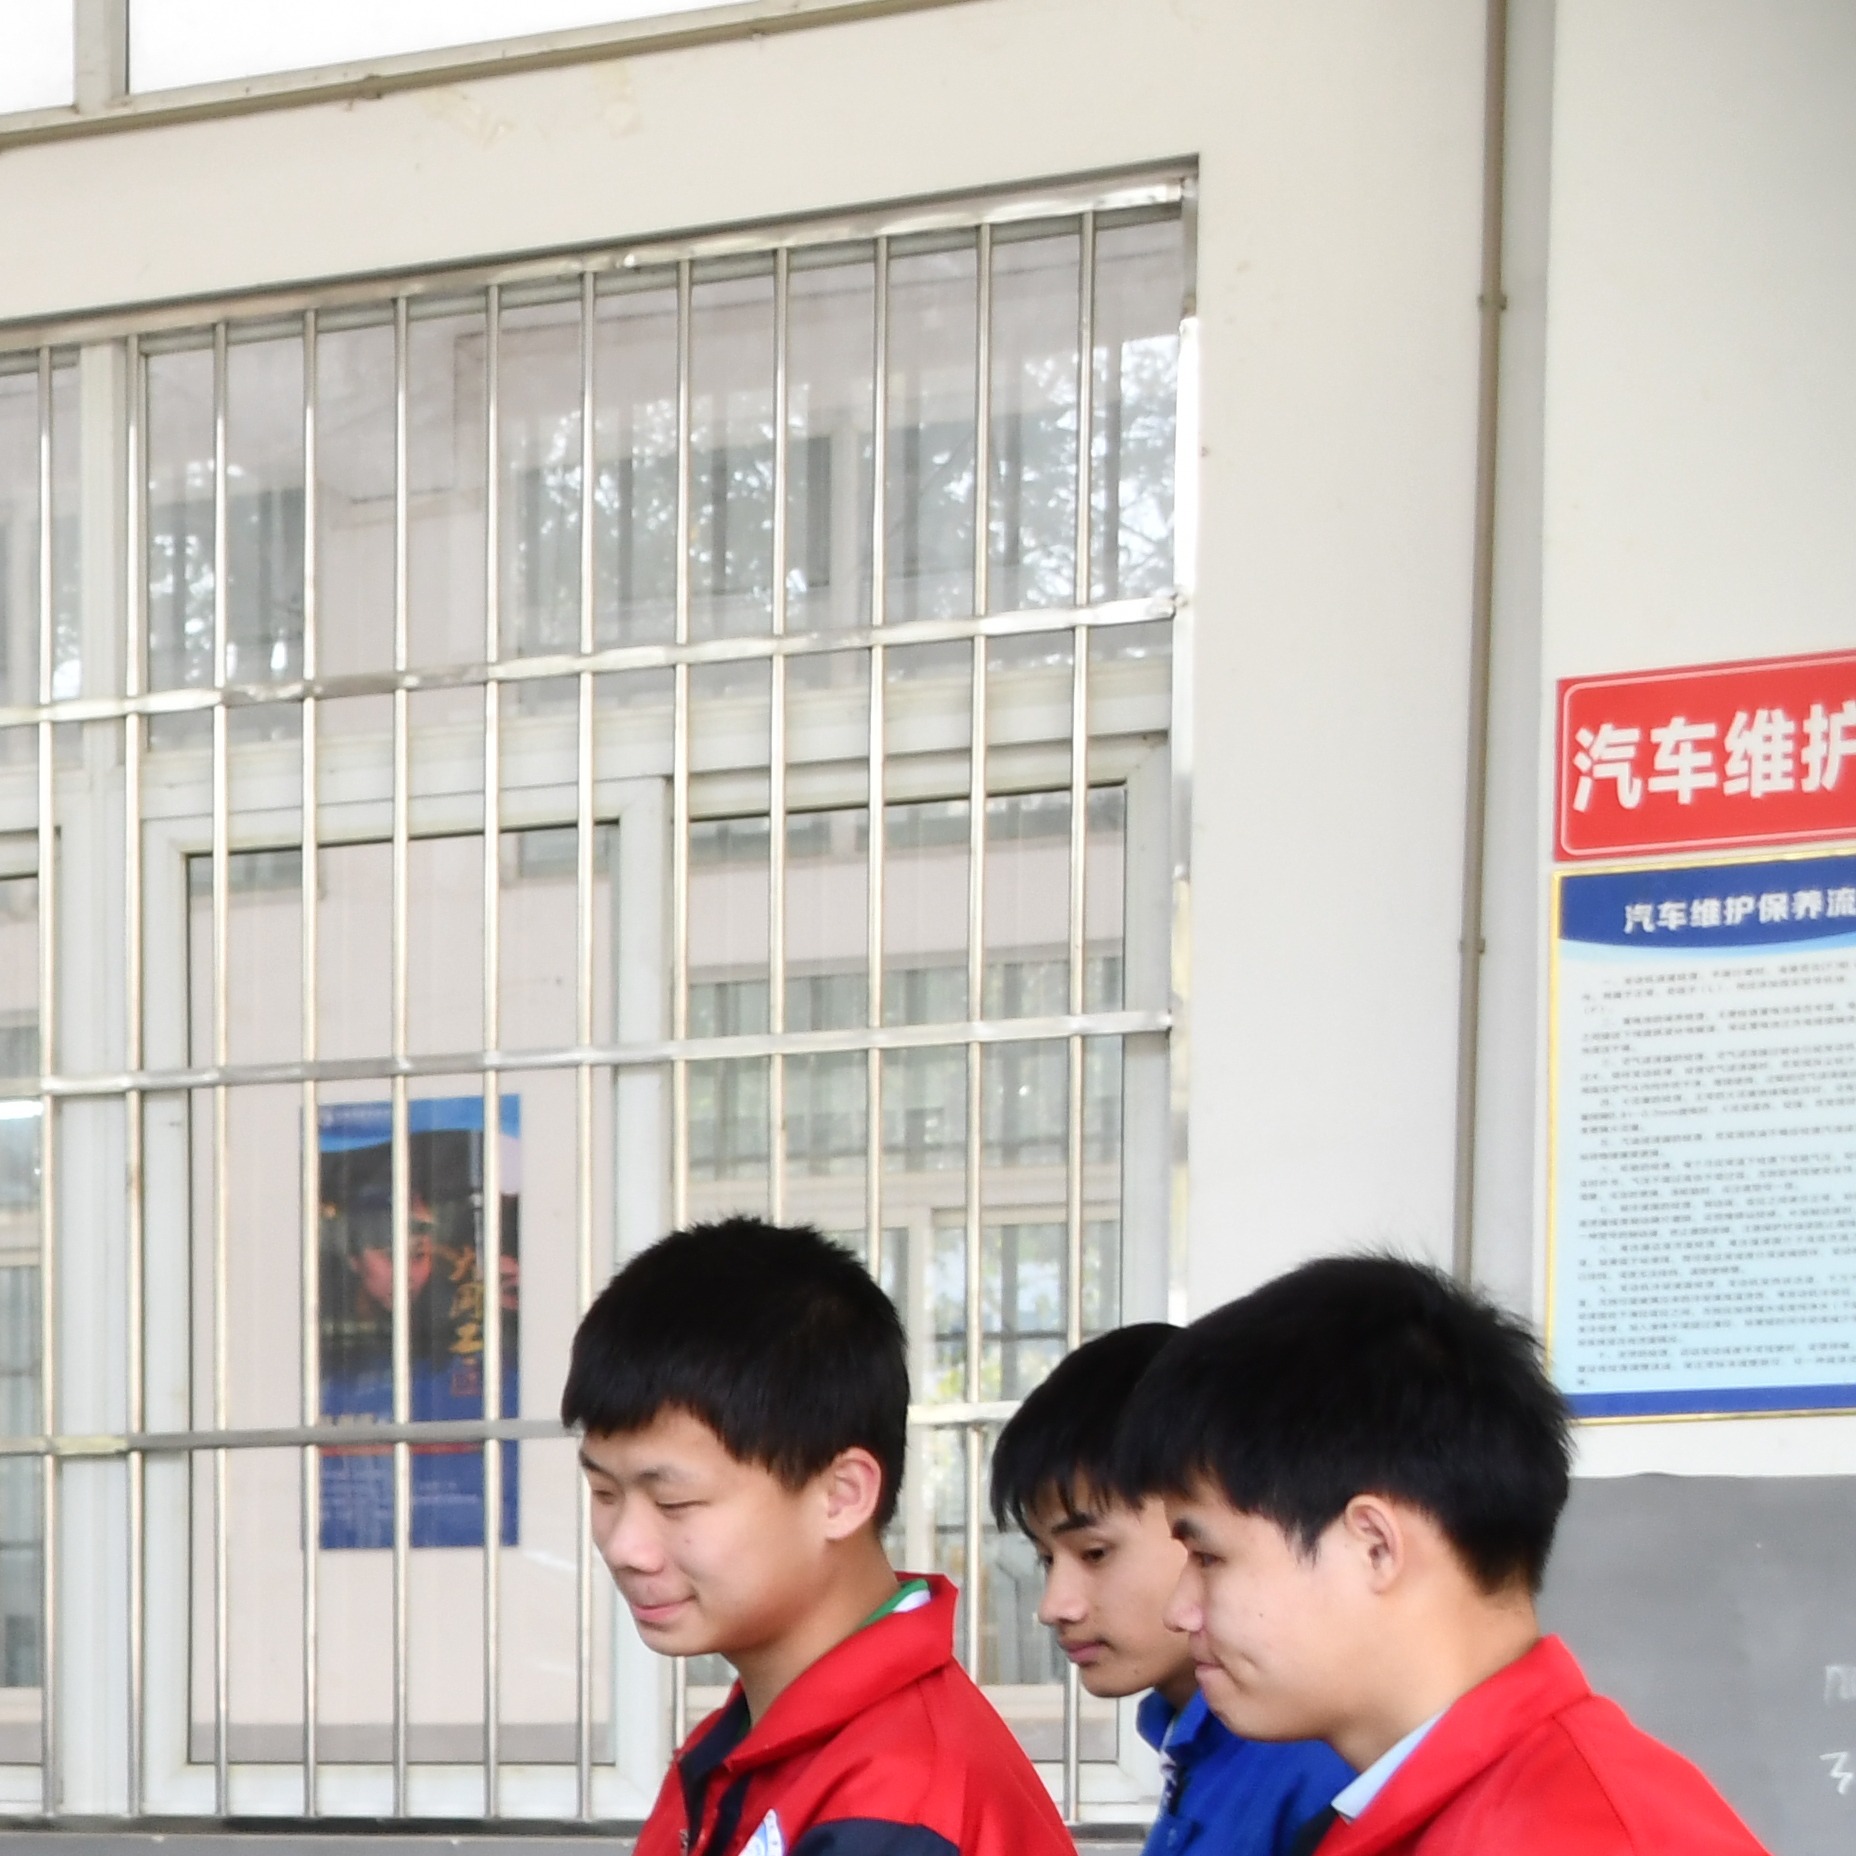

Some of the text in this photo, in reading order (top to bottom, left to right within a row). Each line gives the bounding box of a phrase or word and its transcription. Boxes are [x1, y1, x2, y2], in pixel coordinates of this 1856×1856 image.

[1572, 699, 1856, 813] 汽车维护
[1623, 886, 1856, 933] 汽车维护保养流
